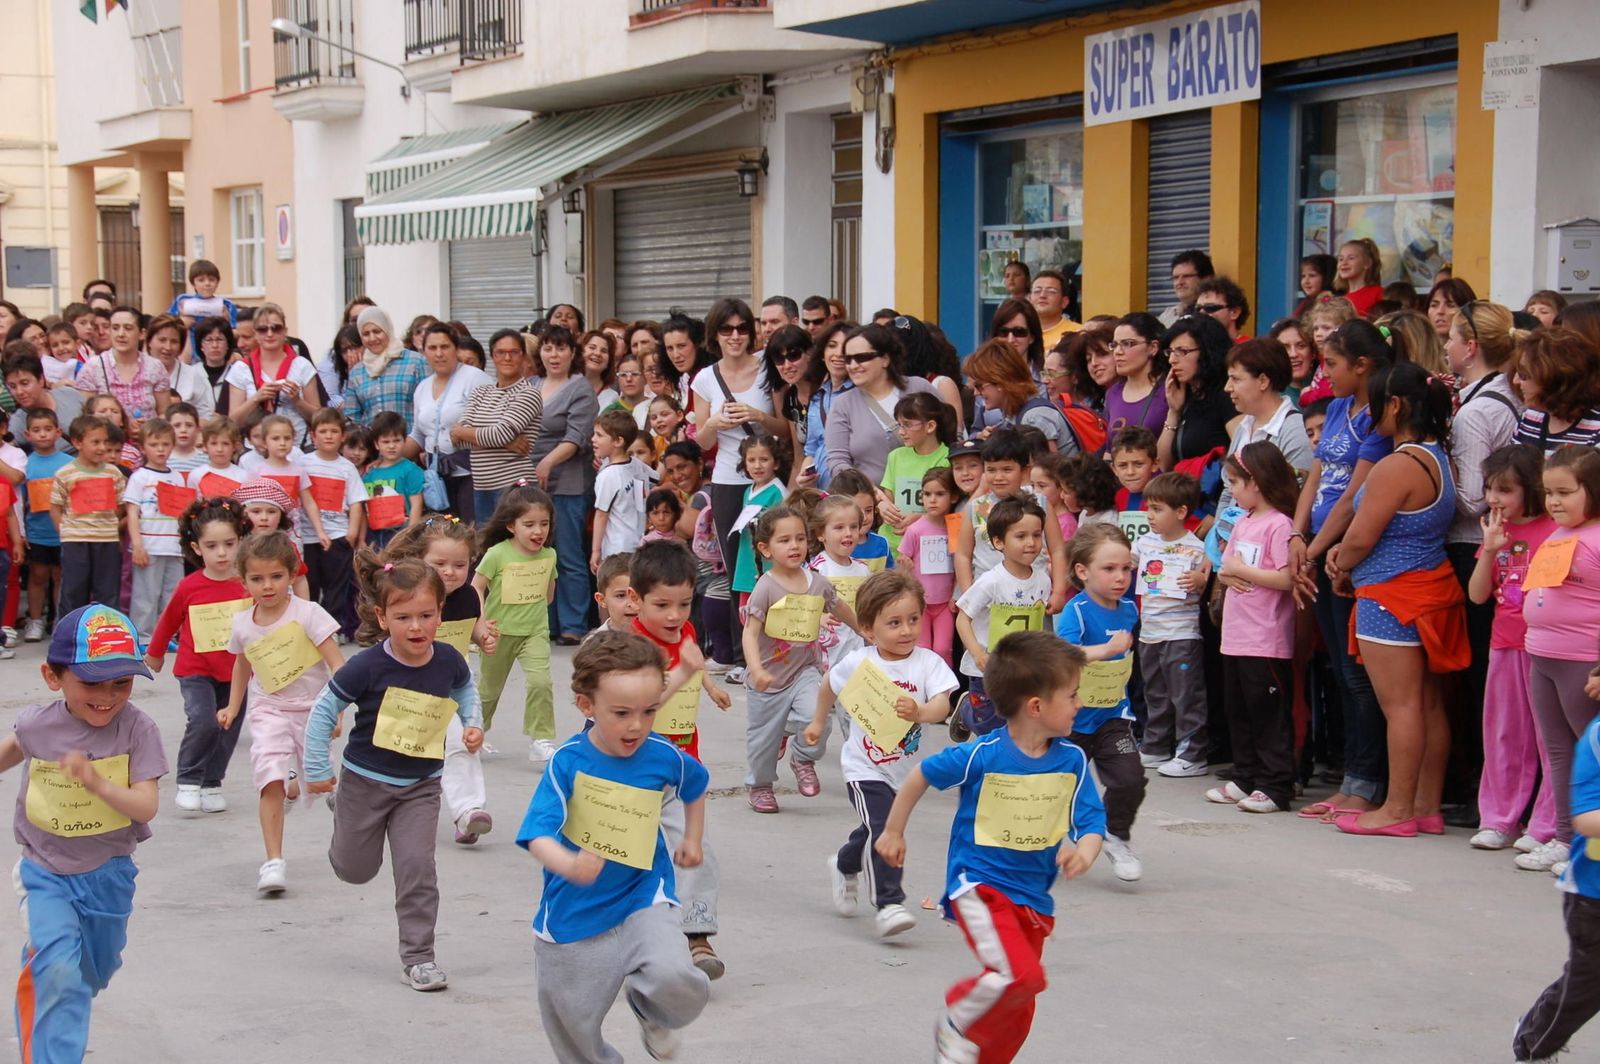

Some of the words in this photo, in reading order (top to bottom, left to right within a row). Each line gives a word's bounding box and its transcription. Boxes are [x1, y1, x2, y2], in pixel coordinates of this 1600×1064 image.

[1090, 33, 1155, 116] SUPER
[1491, 66, 1528, 78] FONTANERO
[851, 703, 859, 714] 3
[670, 718, 677, 729] 3
[393, 735, 402, 746] 3
[51, 817, 59, 831] 3
[64, 821, 103, 832] años
[1002, 829, 1011, 842] 3
[1015, 835, 1048, 845] años
[581, 831, 591, 844] 3
[593, 841, 629, 858] años
